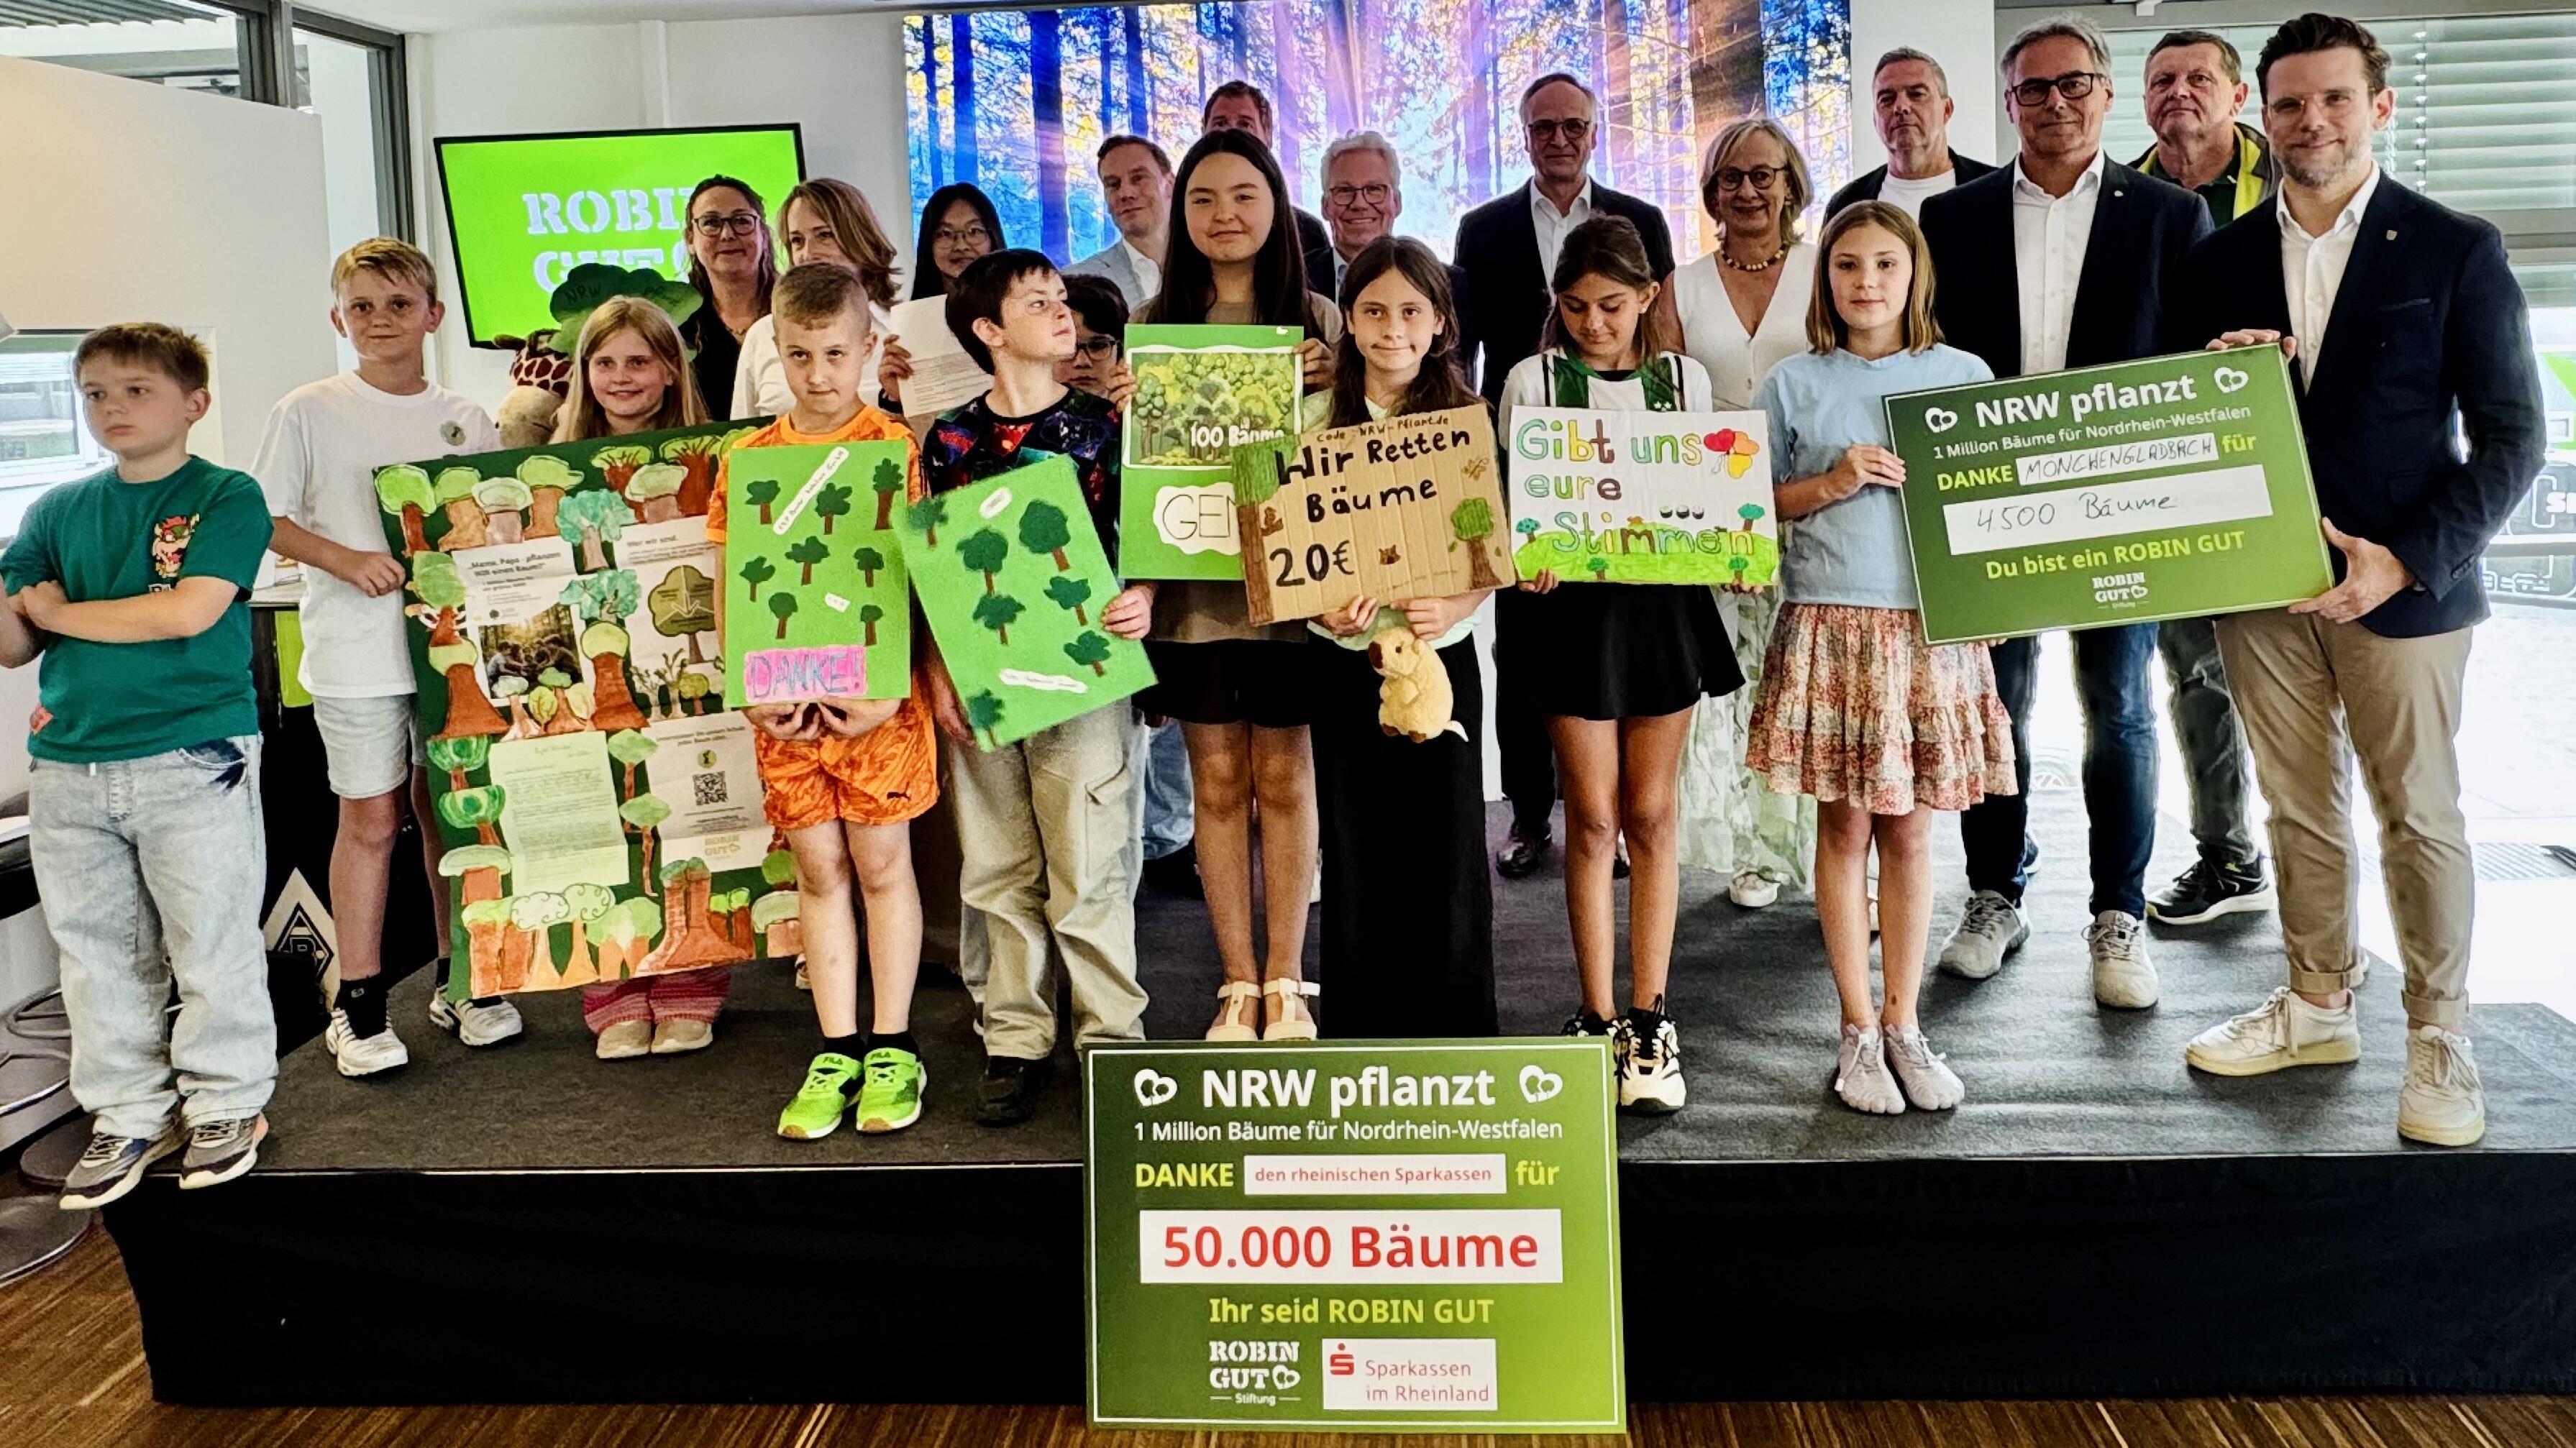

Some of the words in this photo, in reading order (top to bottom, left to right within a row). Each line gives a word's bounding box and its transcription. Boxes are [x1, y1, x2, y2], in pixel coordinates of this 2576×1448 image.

[1976, 391, 2060, 428] NRW
[2070, 375, 2197, 422] pflanzt
[1191, 421, 1224, 448] 100
[1516, 418, 1615, 464] Gibt
[1630, 432, 1704, 466] uns
[1933, 446, 1944, 459] 1
[1946, 441, 1999, 458] Million
[2002, 433, 2055, 450] Bäume
[2058, 429, 2082, 442] für
[2086, 406, 2252, 439] Nordrhein-Westfalen
[1274, 445, 1354, 485] Wir
[1366, 430, 1470, 464] Retten
[1937, 464, 2014, 492] DANKE
[2221, 433, 2257, 453] für
[1306, 479, 1438, 523] Bäume
[1523, 473, 1622, 501] eure
[1551, 511, 1755, 556] Stimmen
[1269, 540, 1355, 587] 20€
[1986, 561, 2018, 579] Du
[2022, 554, 2068, 574] bist
[2072, 548, 2109, 569] ein
[2113, 537, 2191, 564] ROBIN
[2197, 531, 2244, 553] GUT
[2092, 572, 2145, 589] ROBIN
[2095, 588, 2130, 603] GUT
[751, 651, 862, 698] DANKE!
[823, 1056, 844, 1066] FILA
[870, 1051, 892, 1060] FILA
[1203, 1069, 1317, 1107] NRW
[1330, 1066, 1496, 1119] pflanzt
[1134, 1122, 1143, 1141] 1
[1152, 1120, 1222, 1141] Million
[1228, 1120, 1302, 1141] Bäume
[1307, 1119, 1338, 1141] für
[1343, 1118, 1563, 1140] Nordrhein-Westfalen
[1135, 1163, 1234, 1188] DANKE
[1255, 1167, 1286, 1182] den
[1291, 1167, 1390, 1182] rheinischen
[1394, 1166, 1492, 1185] Sparkassen
[1515, 1160, 1560, 1186] für
[1164, 1226, 1331, 1269] 50.000
[1351, 1224, 1538, 1269] Bäume
[1209, 1297, 1253, 1324] Ihr
[1260, 1297, 1319, 1324] seid
[1328, 1298, 1425, 1324] ROBIN
[1434, 1298, 1494, 1324] GUT
[1208, 1340, 1300, 1363] ROBIN
[1209, 1367, 1270, 1390] GUT
[1365, 1360, 1471, 1383] Sparkassen
[1234, 1392, 1276, 1406] Stiftung
[1366, 1386, 1388, 1402] im
[1395, 1385, 1489, 1402] Rheinland
